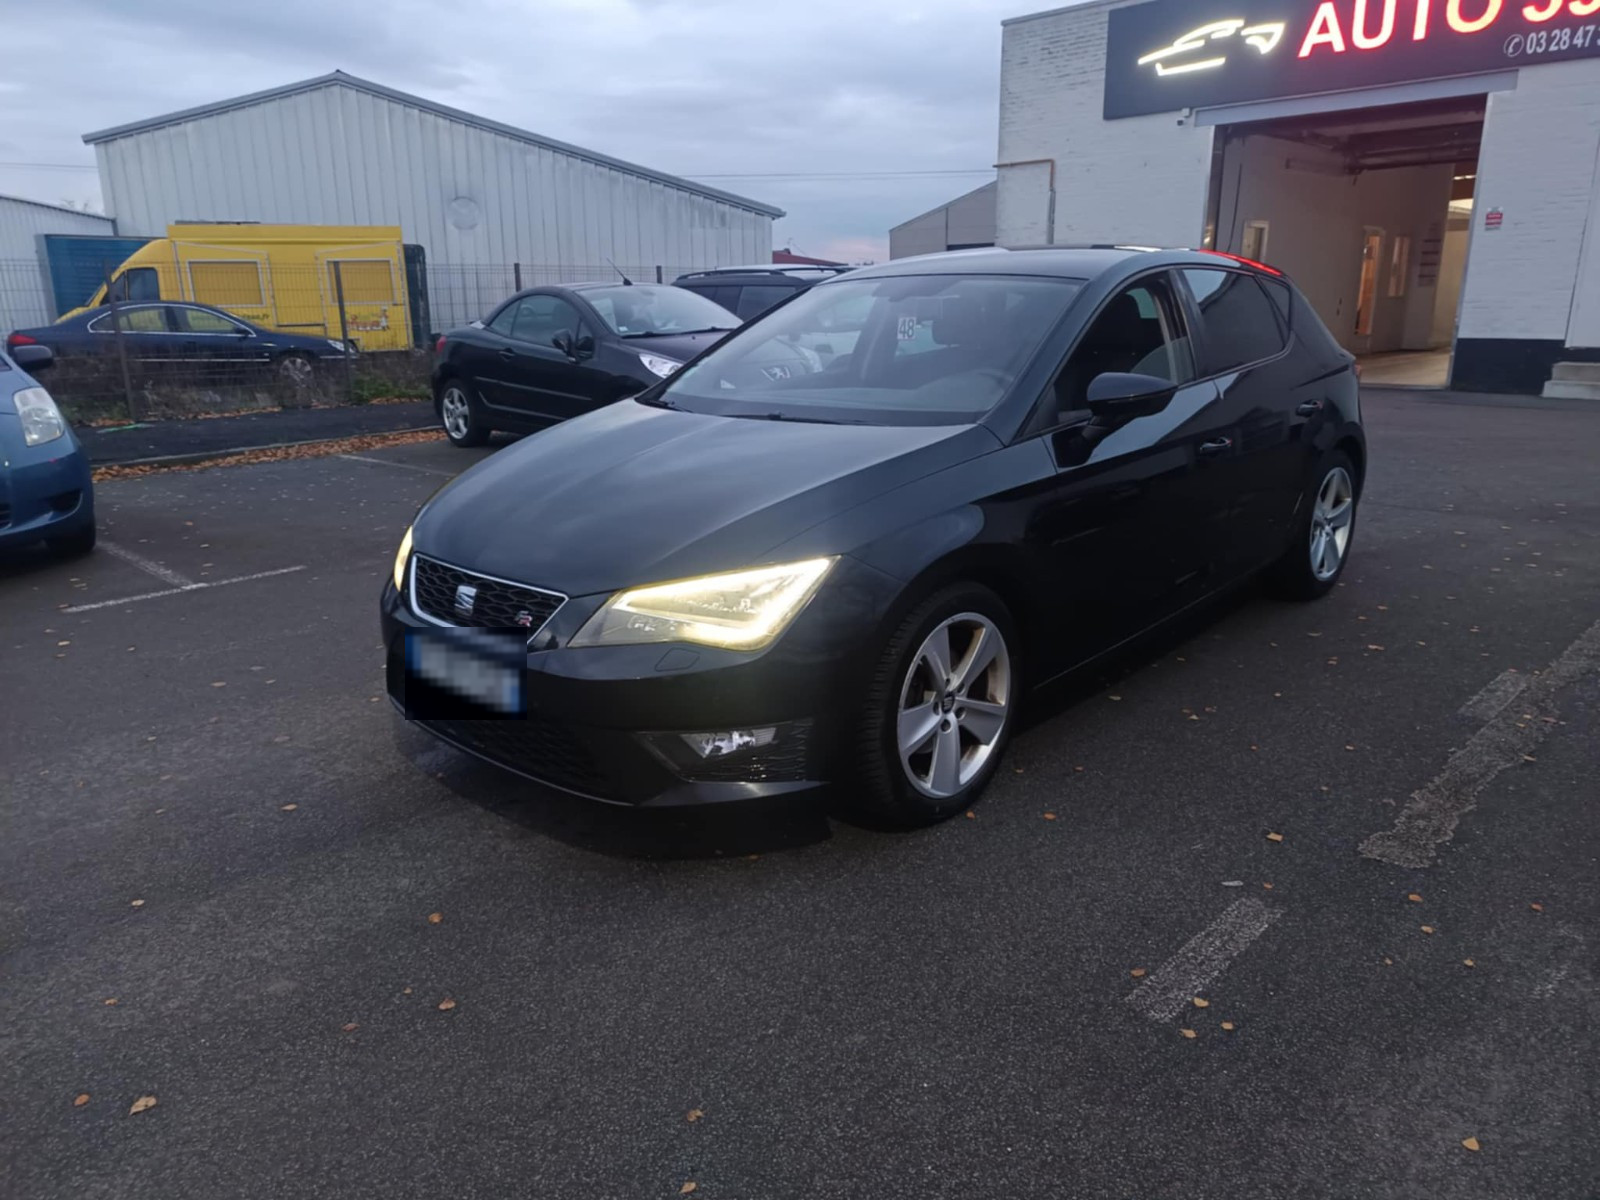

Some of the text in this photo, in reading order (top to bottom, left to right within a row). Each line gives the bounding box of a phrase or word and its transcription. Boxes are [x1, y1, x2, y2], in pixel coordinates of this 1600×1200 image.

[1526, 30, 1547, 54] 03
[1548, 27, 1571, 52] 28
[1573, 25, 1596, 48] 47
[898, 318, 915, 338] 48
